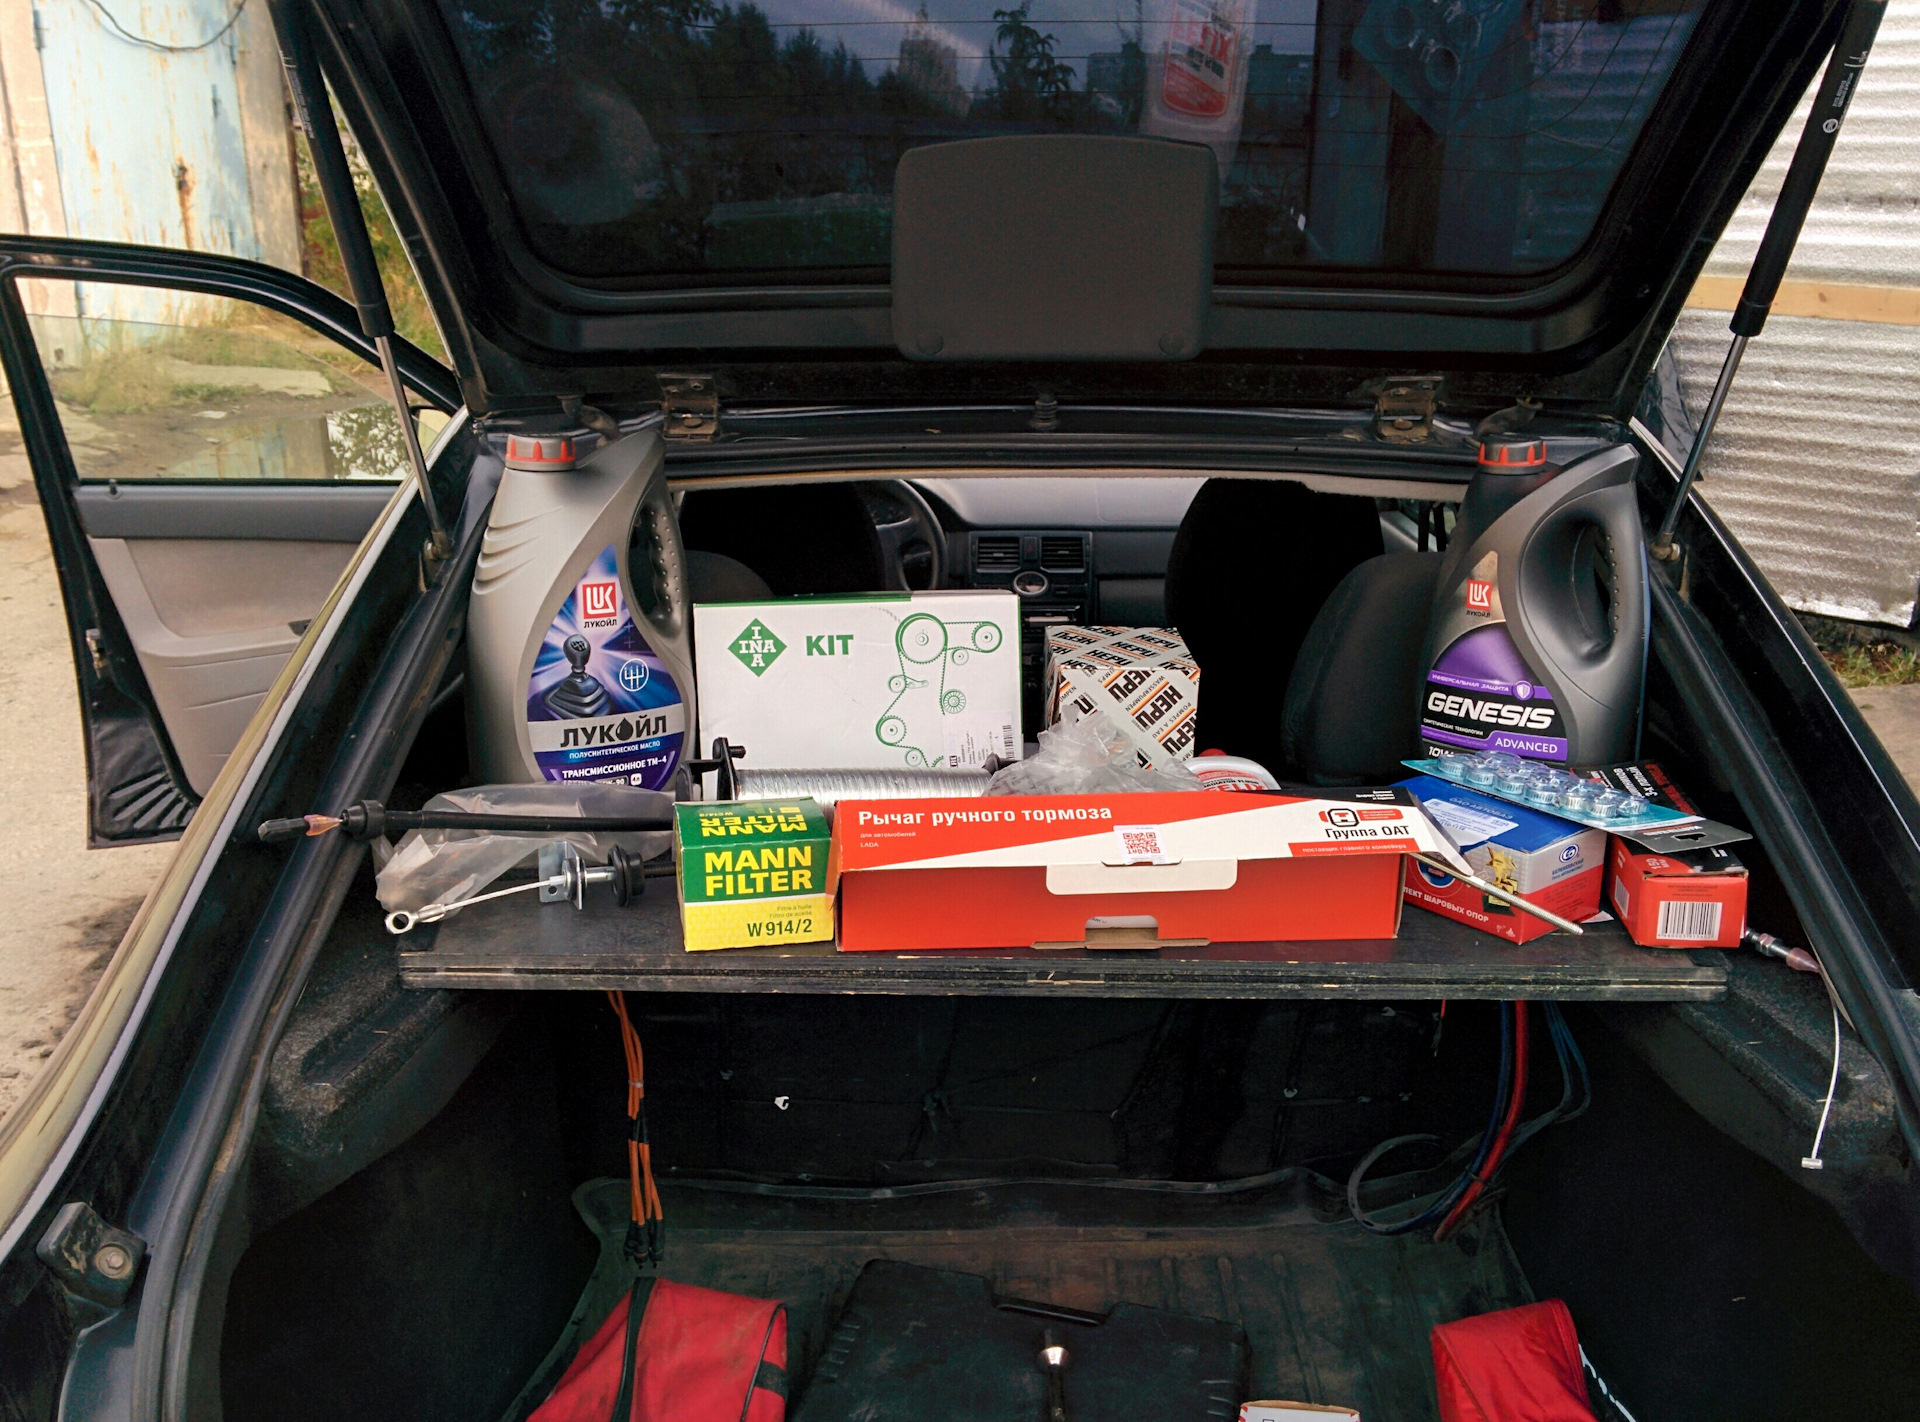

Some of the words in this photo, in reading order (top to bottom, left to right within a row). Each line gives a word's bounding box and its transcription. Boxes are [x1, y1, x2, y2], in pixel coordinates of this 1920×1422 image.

[584, 618, 618, 629] ЛУКОЙЛ
[806, 634, 854, 656] KIT
[1052, 631, 1097, 645] HEPU
[1135, 634, 1181, 650] HEPU
[1086, 649, 1133, 666] HEPU
[1111, 641, 1157, 658] HEPU
[1432, 673, 1480, 688] УНИВЕРСАЛЬНАЯ
[1480, 683, 1510, 693] ЗАЩИТА
[1135, 685, 1183, 726] HEPU
[1427, 691, 1555, 730] GENESIS
[560, 714, 667, 748] ЛУКОЙЛ
[569, 744, 639, 760] ПОЛУСИНТЕТИЧЕСКОЕ
[639, 740, 661, 751] МАСЛО
[1495, 737, 1558, 754] ADVANCED
[562, 759, 647, 779] ТРАНСМИССИОННОЕ
[647, 755, 668, 768] ТМ-4
[700, 814, 805, 827] FILTER
[858, 810, 925, 826] Рычаг
[932, 808, 1016, 827] ручного
[1021, 807, 1113, 824] тормоза
[701, 822, 808, 837] MANN
[1325, 827, 1378, 840] Группа
[1381, 825, 1410, 836] ОАТ
[1339, 844, 1371, 852] главного
[705, 846, 812, 873] MANN
[706, 869, 813, 897] FILTER
[1423, 893, 1465, 915] ШАРОВЫХ
[1466, 909, 1489, 923] ОПОР
[747, 922, 763, 937] W
[765, 918, 812, 937] 914/2
